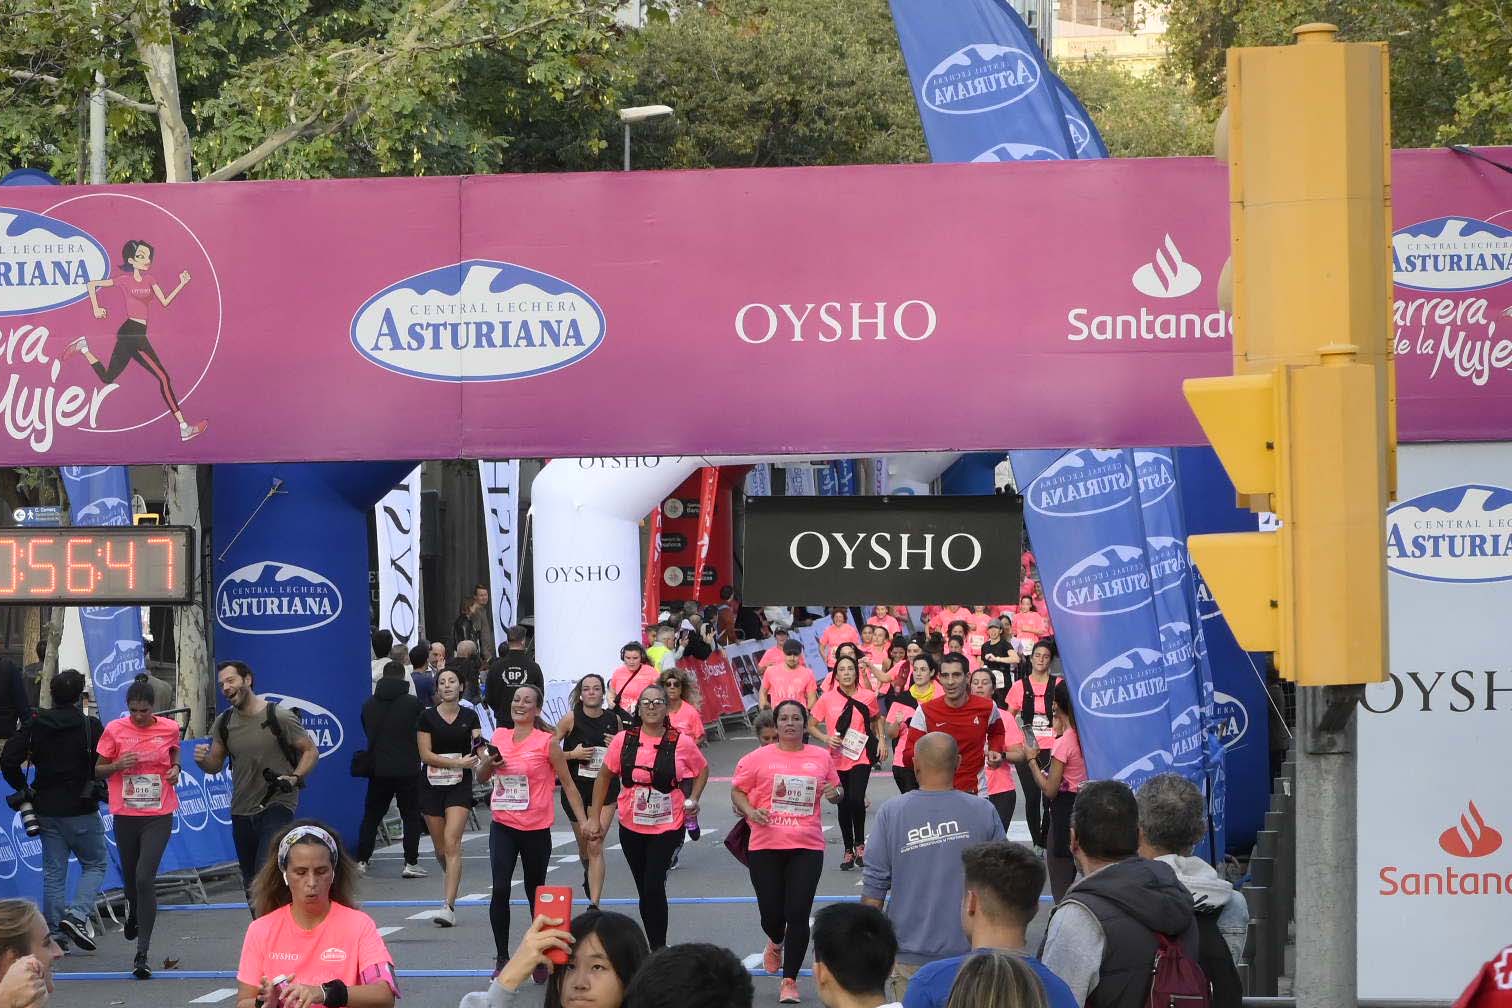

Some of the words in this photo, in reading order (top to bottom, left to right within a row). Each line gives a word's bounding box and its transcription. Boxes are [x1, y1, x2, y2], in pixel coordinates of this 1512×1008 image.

[13, 243, 86, 255] LECHERA
[1407, 243, 1458, 251] CENTRAL
[410, 302, 489, 316] CENTRAL
[496, 300, 578, 314] LECHERA
[1392, 297, 1489, 327] arrera
[370, 307, 586, 352] ASTURIANA
[734, 300, 937, 344] OYSHO
[1416, 327, 1434, 355] la
[1429, 320, 1512, 386] Muje
[1414, 519, 1482, 530] CENTRAL
[790, 531, 982, 572] OYSHO
[545, 564, 621, 585] OYSHO
[232, 587, 275, 595] CENTRAL
[279, 585, 329, 594] LECHERA
[219, 591, 333, 619] ASTURIANA
[508, 672, 522, 680] BP
[301, 718, 329, 726] HERA
